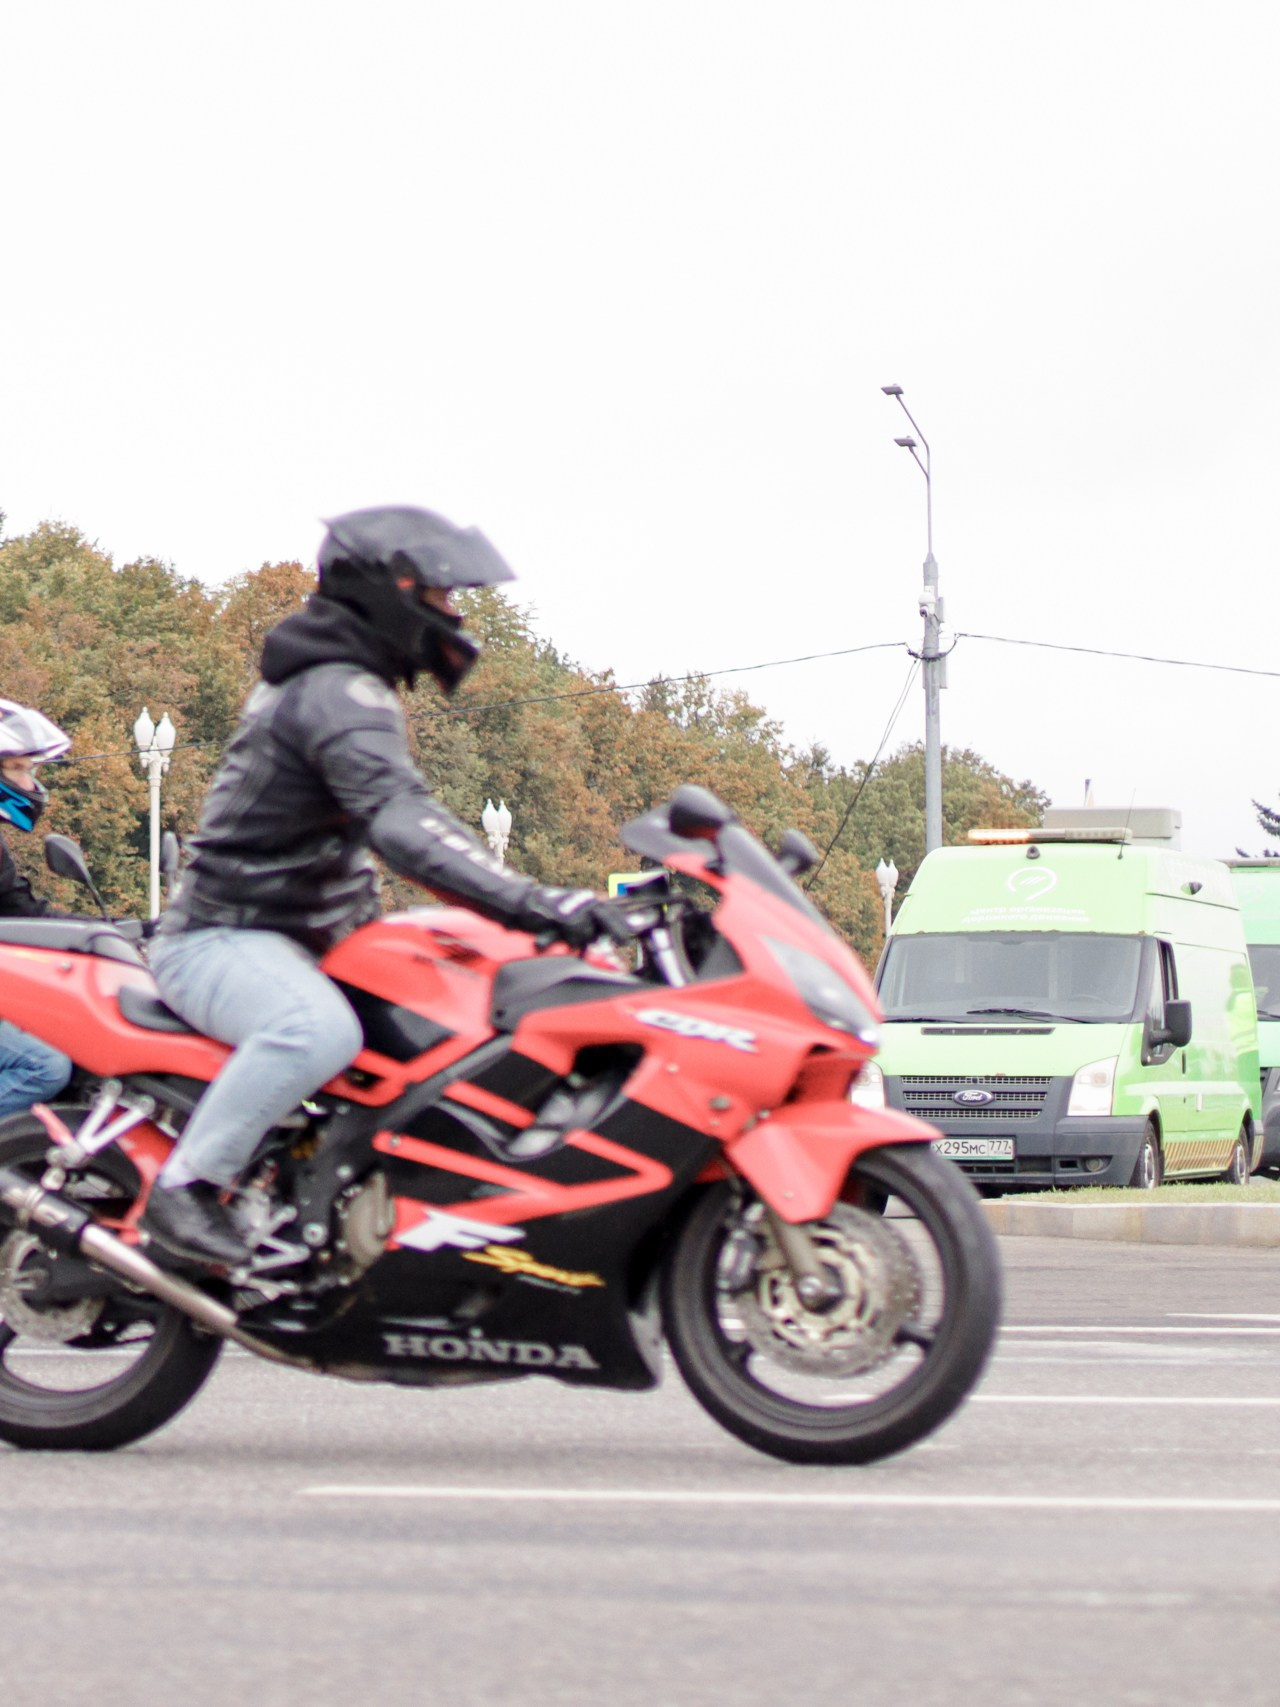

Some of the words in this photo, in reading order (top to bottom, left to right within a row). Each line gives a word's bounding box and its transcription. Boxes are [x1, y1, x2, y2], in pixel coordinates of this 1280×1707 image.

[961, 1091, 983, 1101] Ford
[989, 1140, 1009, 1152] 777
[382, 1333, 600, 1370] HONDA
